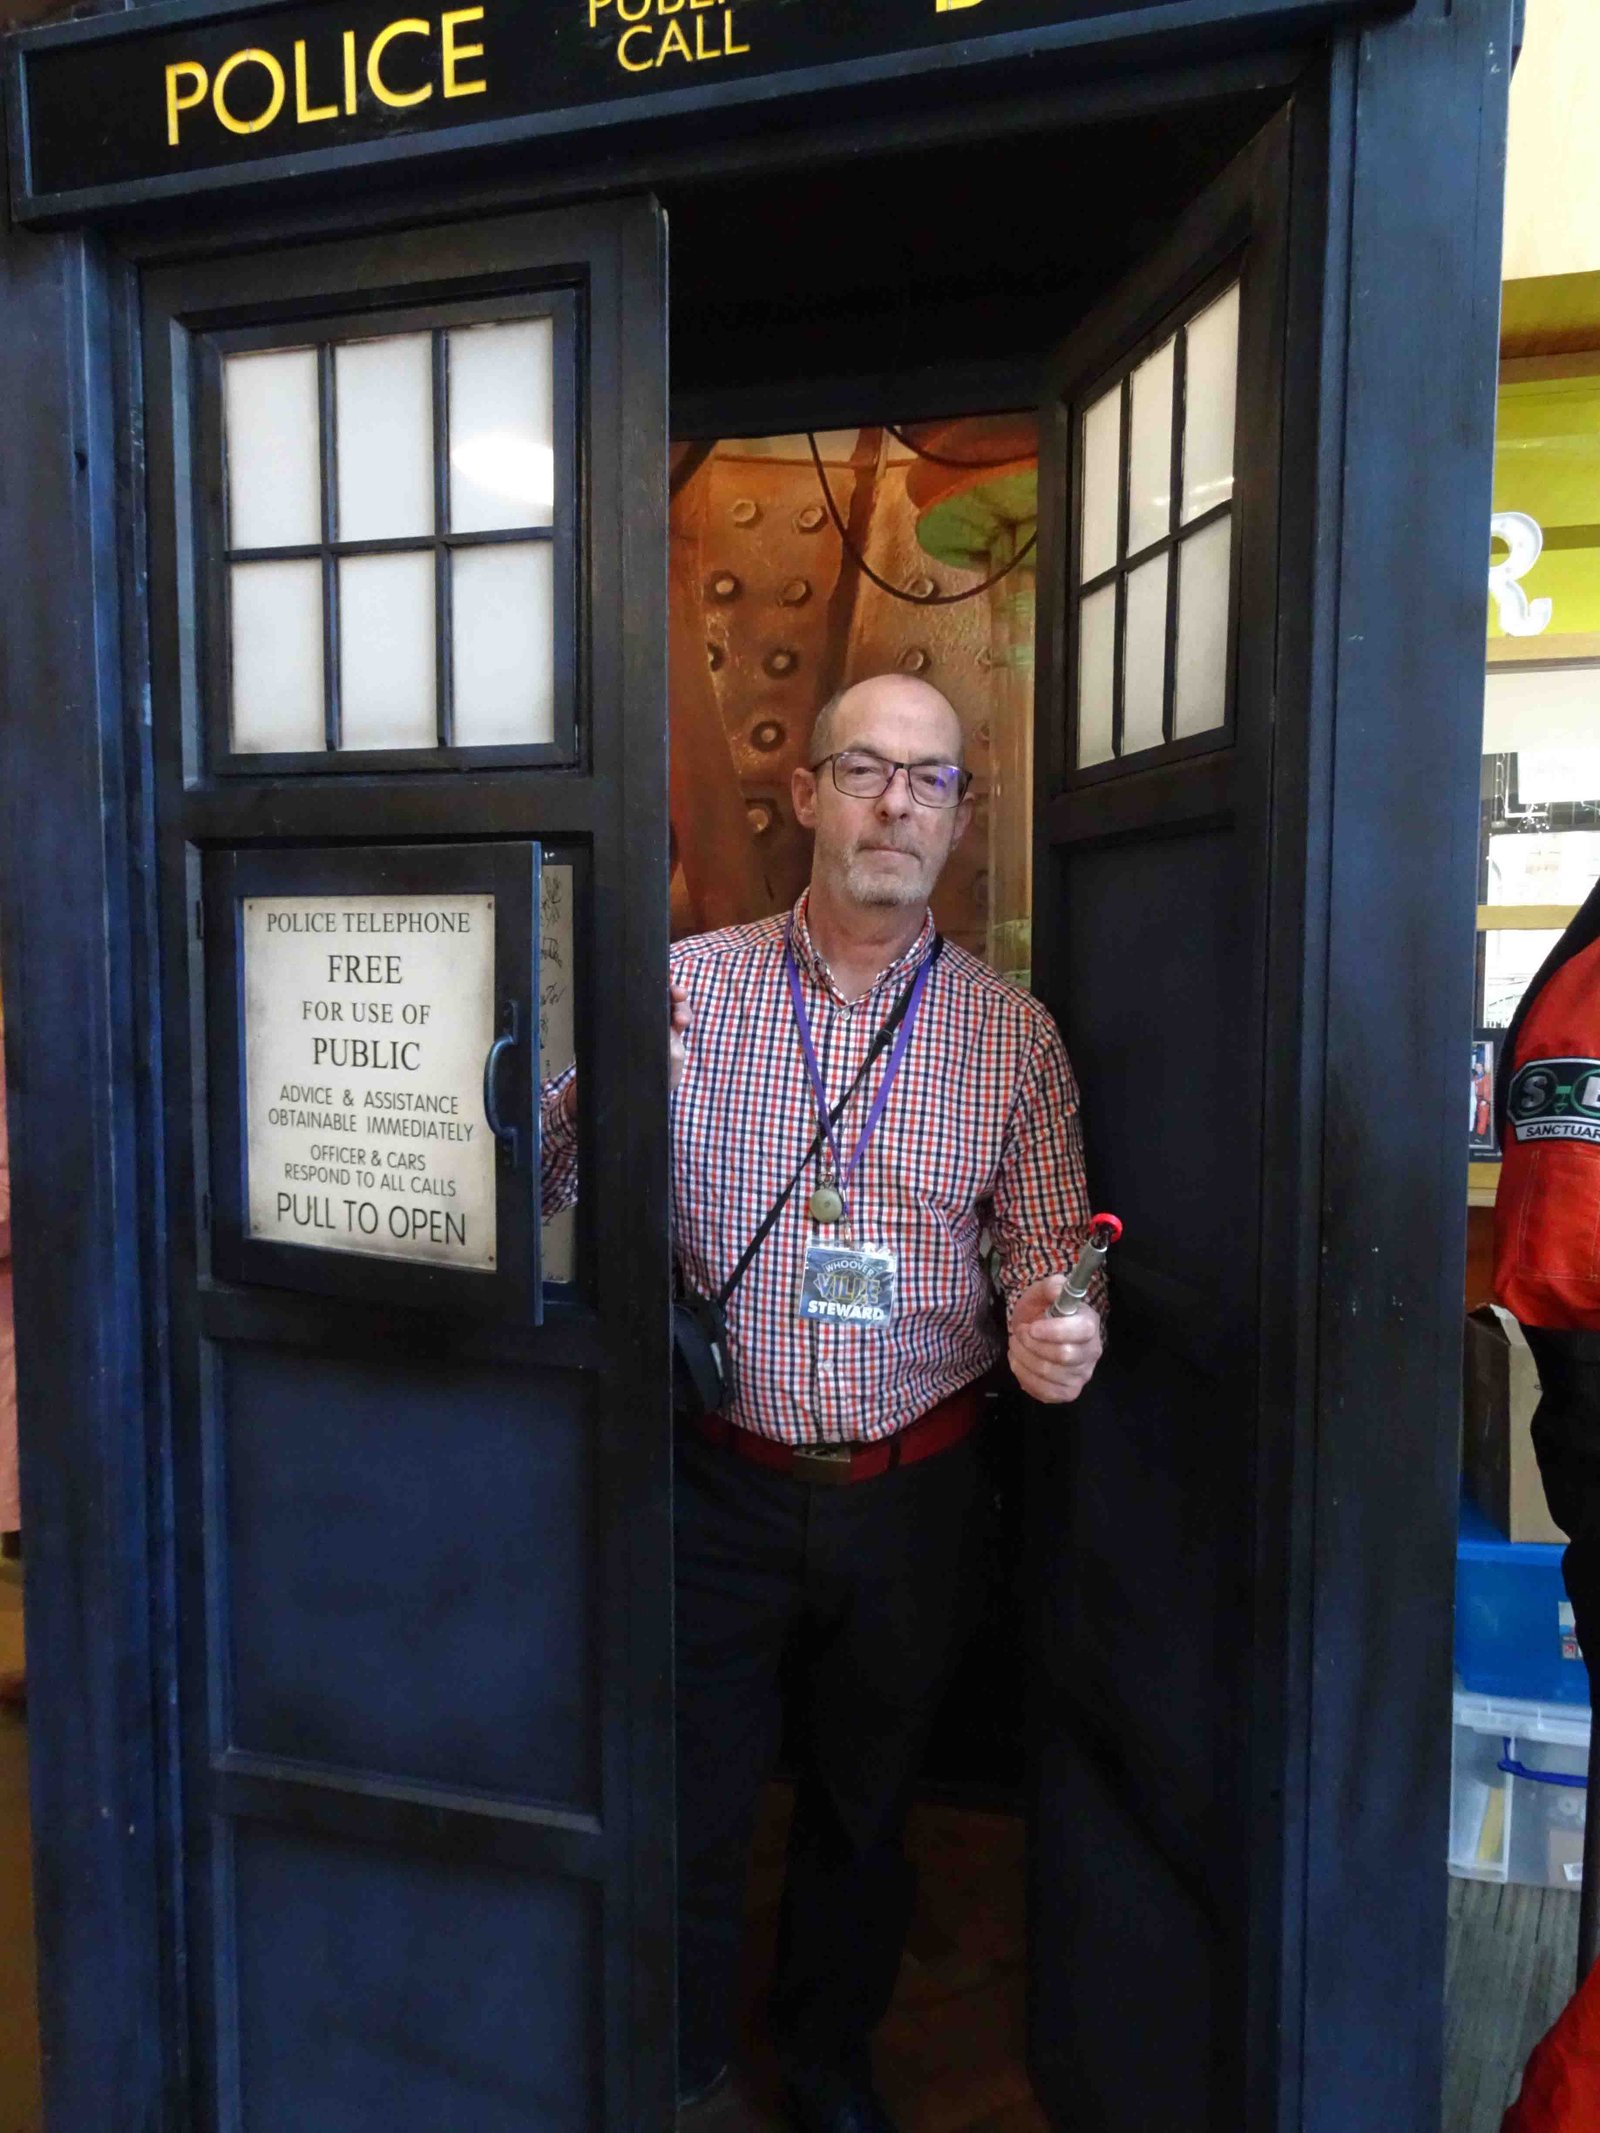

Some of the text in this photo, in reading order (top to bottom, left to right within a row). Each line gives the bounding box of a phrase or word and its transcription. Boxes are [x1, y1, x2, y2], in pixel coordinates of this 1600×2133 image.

[617, 9, 750, 72] CALL
[165, 6, 487, 146] POLICE
[266, 912, 471, 933] POLICE TELEPHONE
[327, 954, 403, 985] FREE
[302, 1000, 431, 1025] FOR USE OF
[312, 1037, 421, 1071] PUBLIC
[279, 1084, 459, 1115] ADVICE & ASSISTANCE
[268, 1108, 474, 1142] OBTAINABLE IMMEDIATELY
[310, 1144, 426, 1172] OFFICER & CARS
[284, 1162, 457, 1198] RESPOND TO ALL CALLS
[277, 1191, 466, 1246] PULL TO OPEN
[825, 1259, 875, 1279] WHOOVER
[807, 1300, 885, 1321] STEWARD
